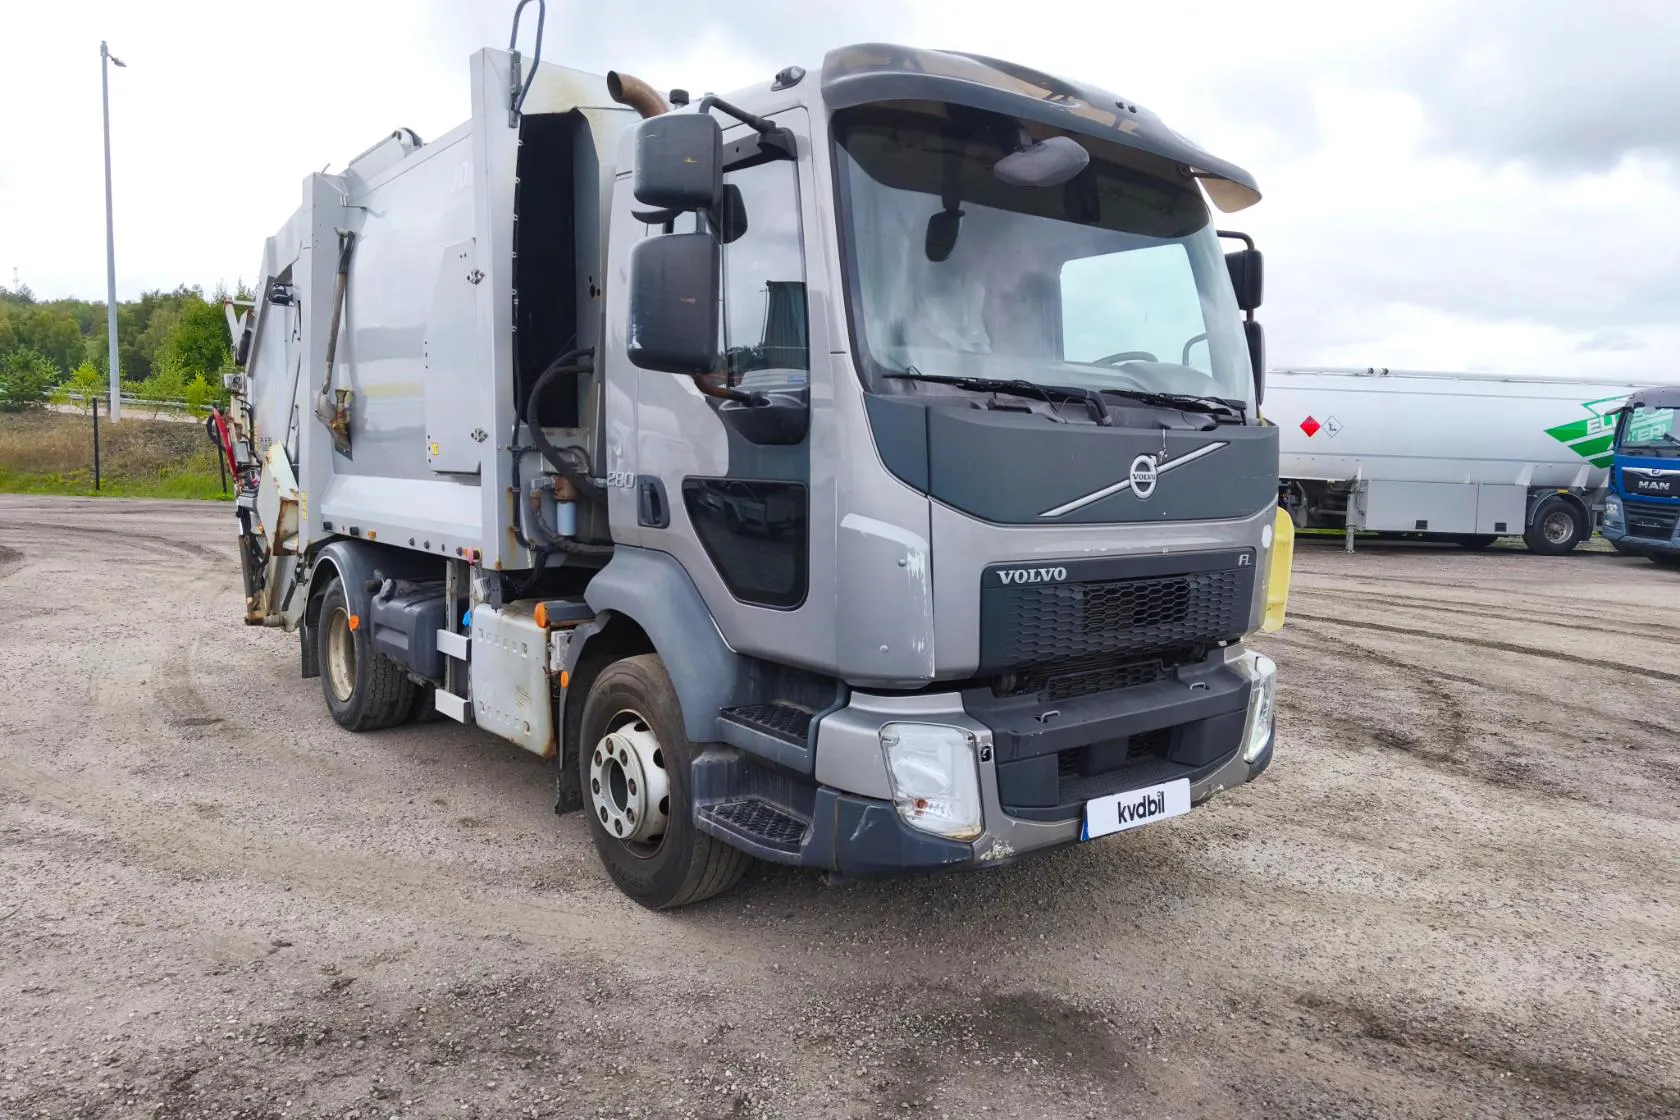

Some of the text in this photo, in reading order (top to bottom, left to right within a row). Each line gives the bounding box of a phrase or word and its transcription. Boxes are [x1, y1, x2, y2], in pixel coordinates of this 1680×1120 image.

[607, 471, 635, 488] 280
[1132, 473, 1156, 481] VOLVO
[1638, 480, 1670, 491] MAN
[1238, 554, 1252, 566] FL
[996, 566, 1067, 585] VOLVO
[1117, 791, 1165, 824] kvdbil
